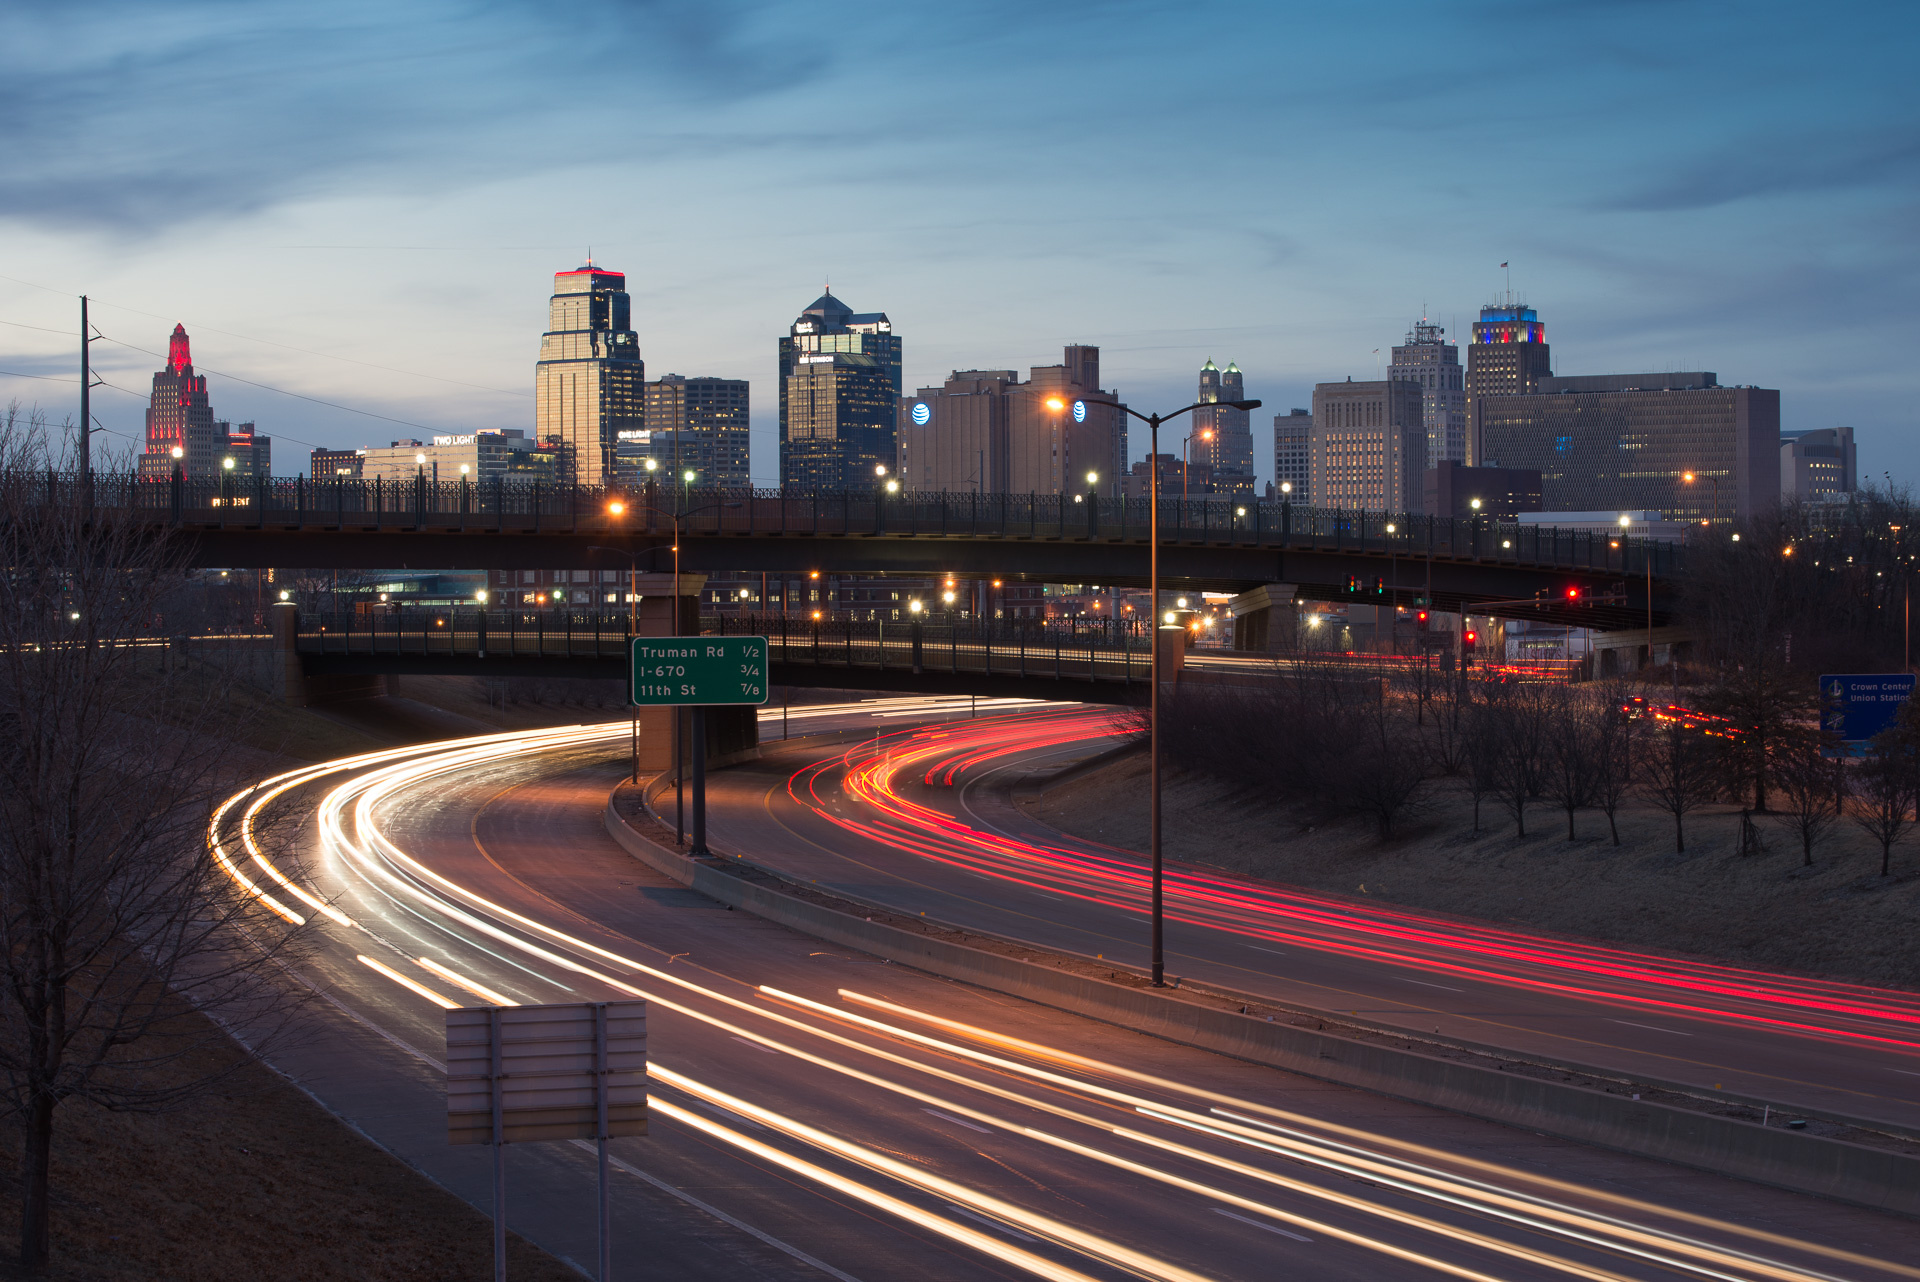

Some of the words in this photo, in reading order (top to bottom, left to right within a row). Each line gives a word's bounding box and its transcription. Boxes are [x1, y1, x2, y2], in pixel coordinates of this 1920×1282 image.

[618, 430, 632, 439] ONE
[632, 429, 651, 438] LIGHT
[433, 436, 452, 445] TWO
[452, 435, 476, 445] LIGHT
[641, 647, 697, 658] Truman
[706, 646, 724, 657] Rd
[743, 645, 759, 657] 1/2
[641, 666, 685, 677] I-670
[740, 664, 759, 676] 3/4
[641, 685, 671, 696] 11th
[681, 684, 696, 695] St
[740, 683, 760, 695] 7/8
[1850, 683, 1878, 691] Crown
[1882, 683, 1911, 691] Center
[1850, 694, 1876, 702] Union
